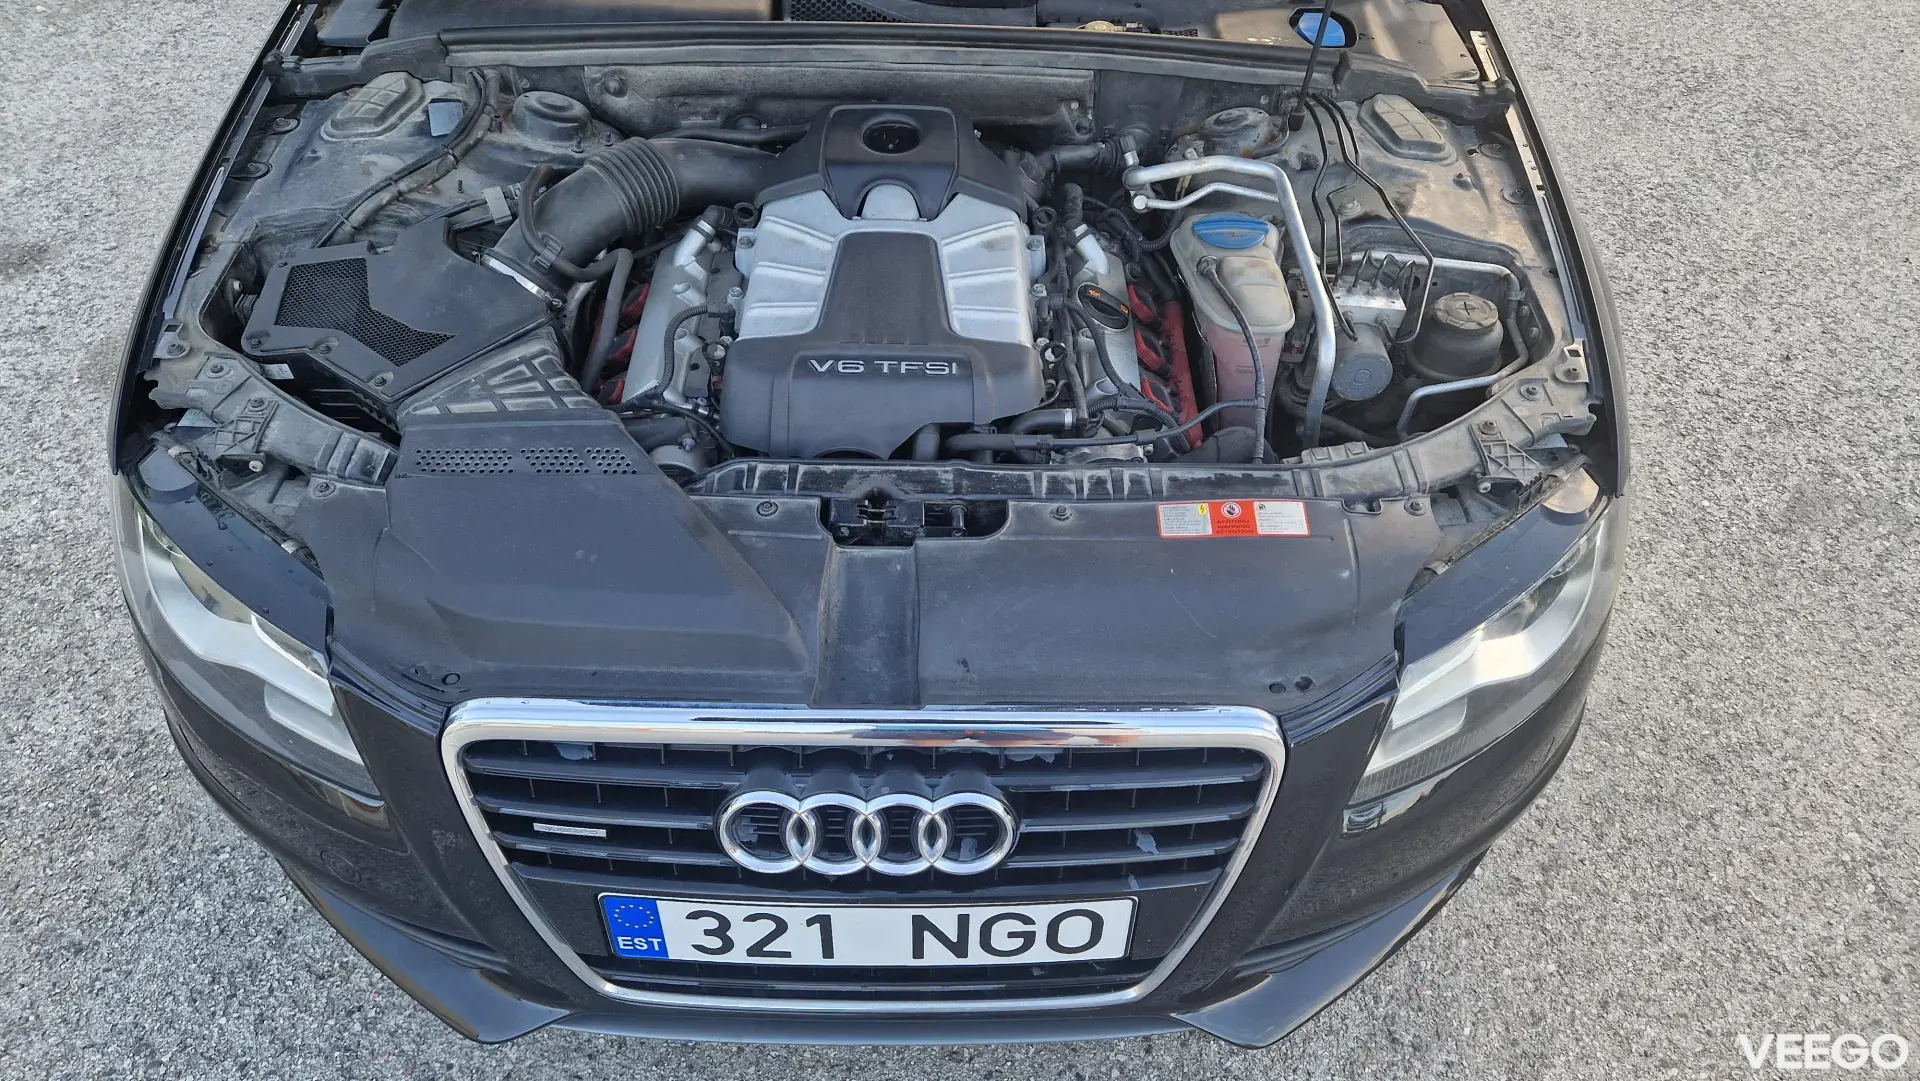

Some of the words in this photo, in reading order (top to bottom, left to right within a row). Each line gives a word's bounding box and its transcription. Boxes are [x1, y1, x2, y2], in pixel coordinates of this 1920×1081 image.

[809, 359, 865, 373] V6
[874, 360, 958, 375] TFSI
[617, 934, 663, 952] EST
[684, 909, 836, 960] 321
[911, 908, 1105, 958] NGO
